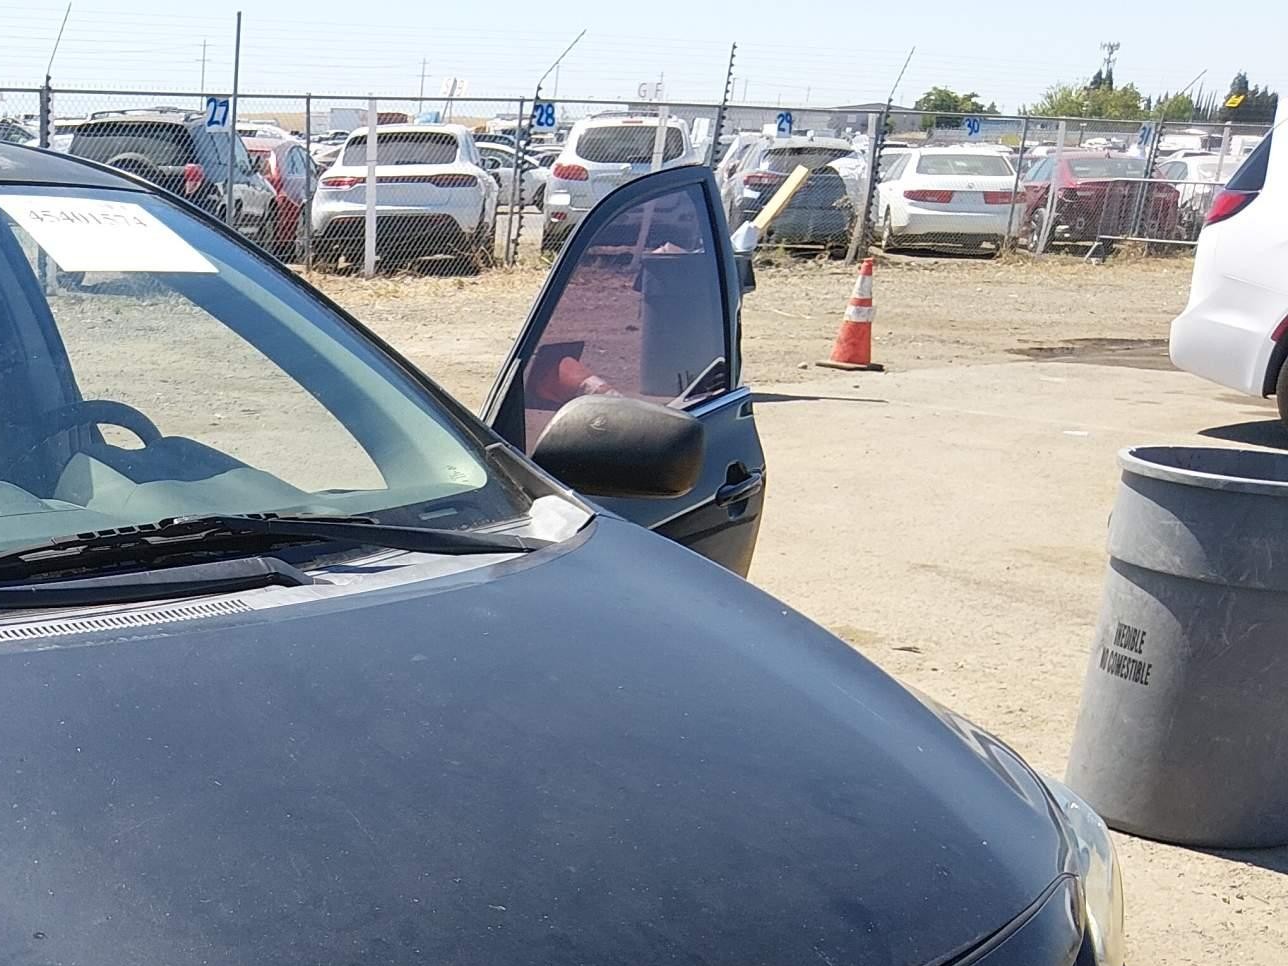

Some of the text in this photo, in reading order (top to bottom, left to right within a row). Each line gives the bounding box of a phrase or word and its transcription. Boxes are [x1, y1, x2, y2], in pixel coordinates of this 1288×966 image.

[207, 98, 229, 127] 27
[535, 103, 555, 127] 28
[777, 112, 792, 135] 29
[965, 118, 980, 136] 30
[1137, 126, 1152, 146] 31
